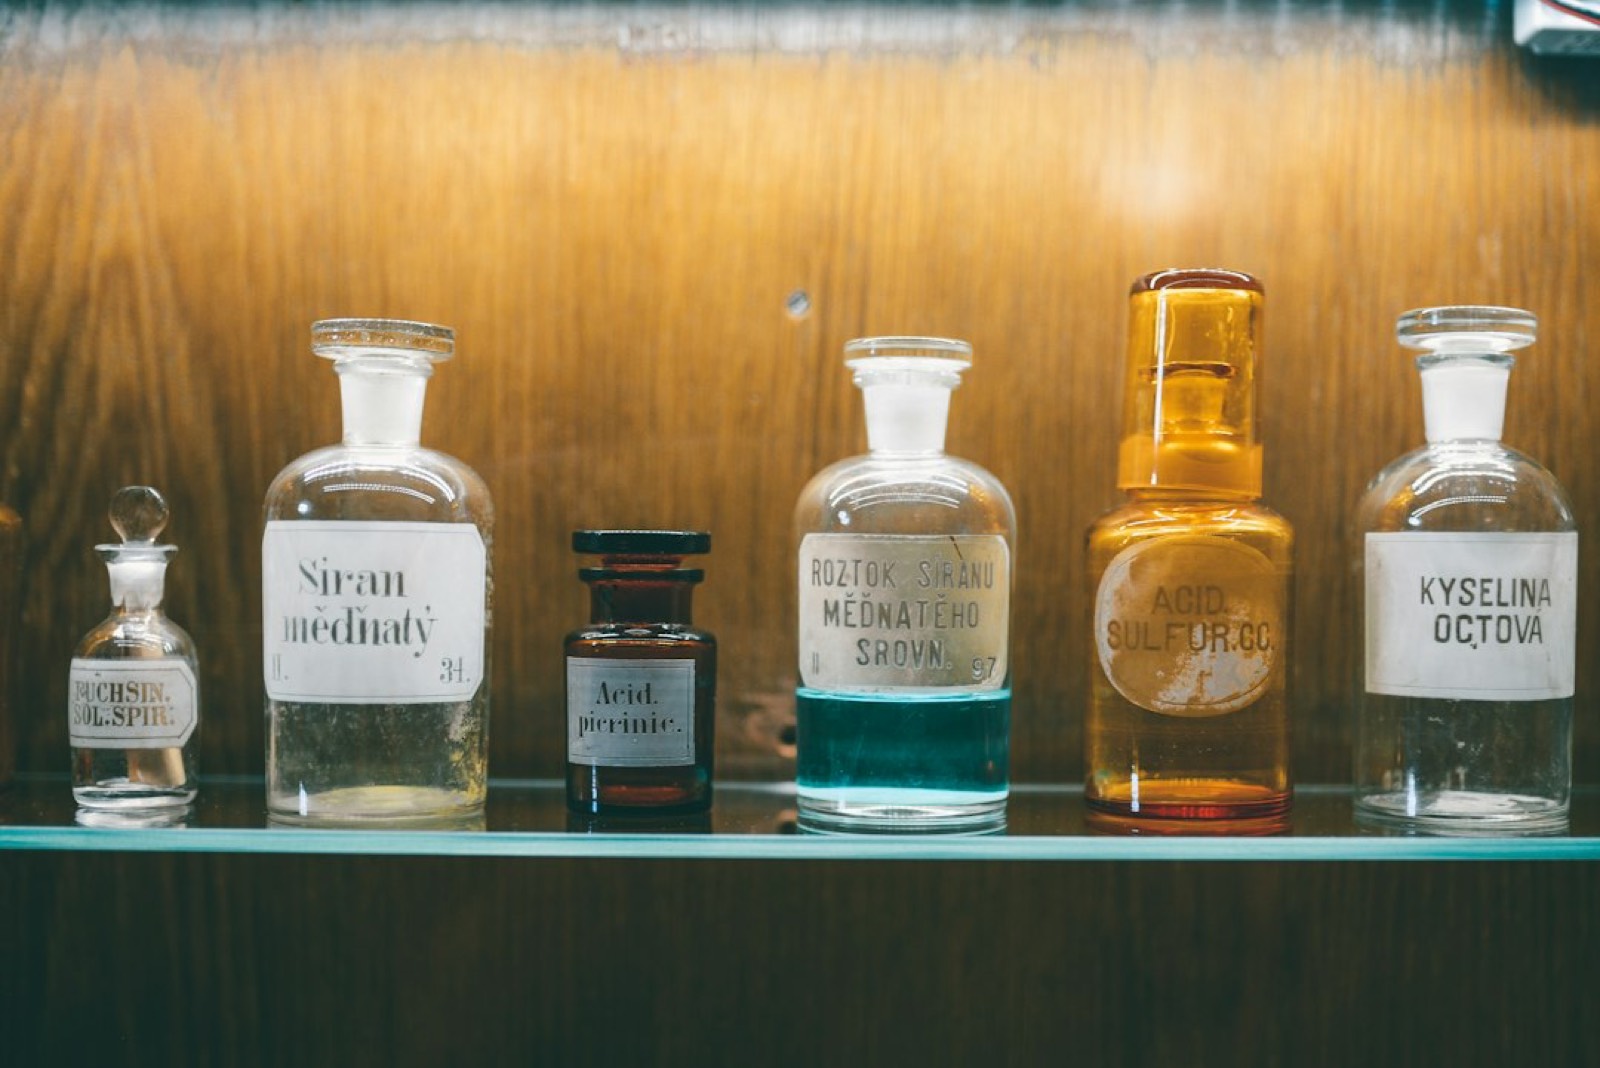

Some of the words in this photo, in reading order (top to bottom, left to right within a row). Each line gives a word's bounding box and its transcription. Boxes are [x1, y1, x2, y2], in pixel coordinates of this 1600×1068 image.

[812, 558, 896, 588] ROZTOK
[1151, 586, 1229, 616] ACID.
[1421, 576, 1551, 607] KYSELINA
[856, 638, 952, 670] SROVN.
[972, 657, 996, 680] 97
[596, 681, 658, 704] Acid.
[579, 711, 682, 737] picrinic.
